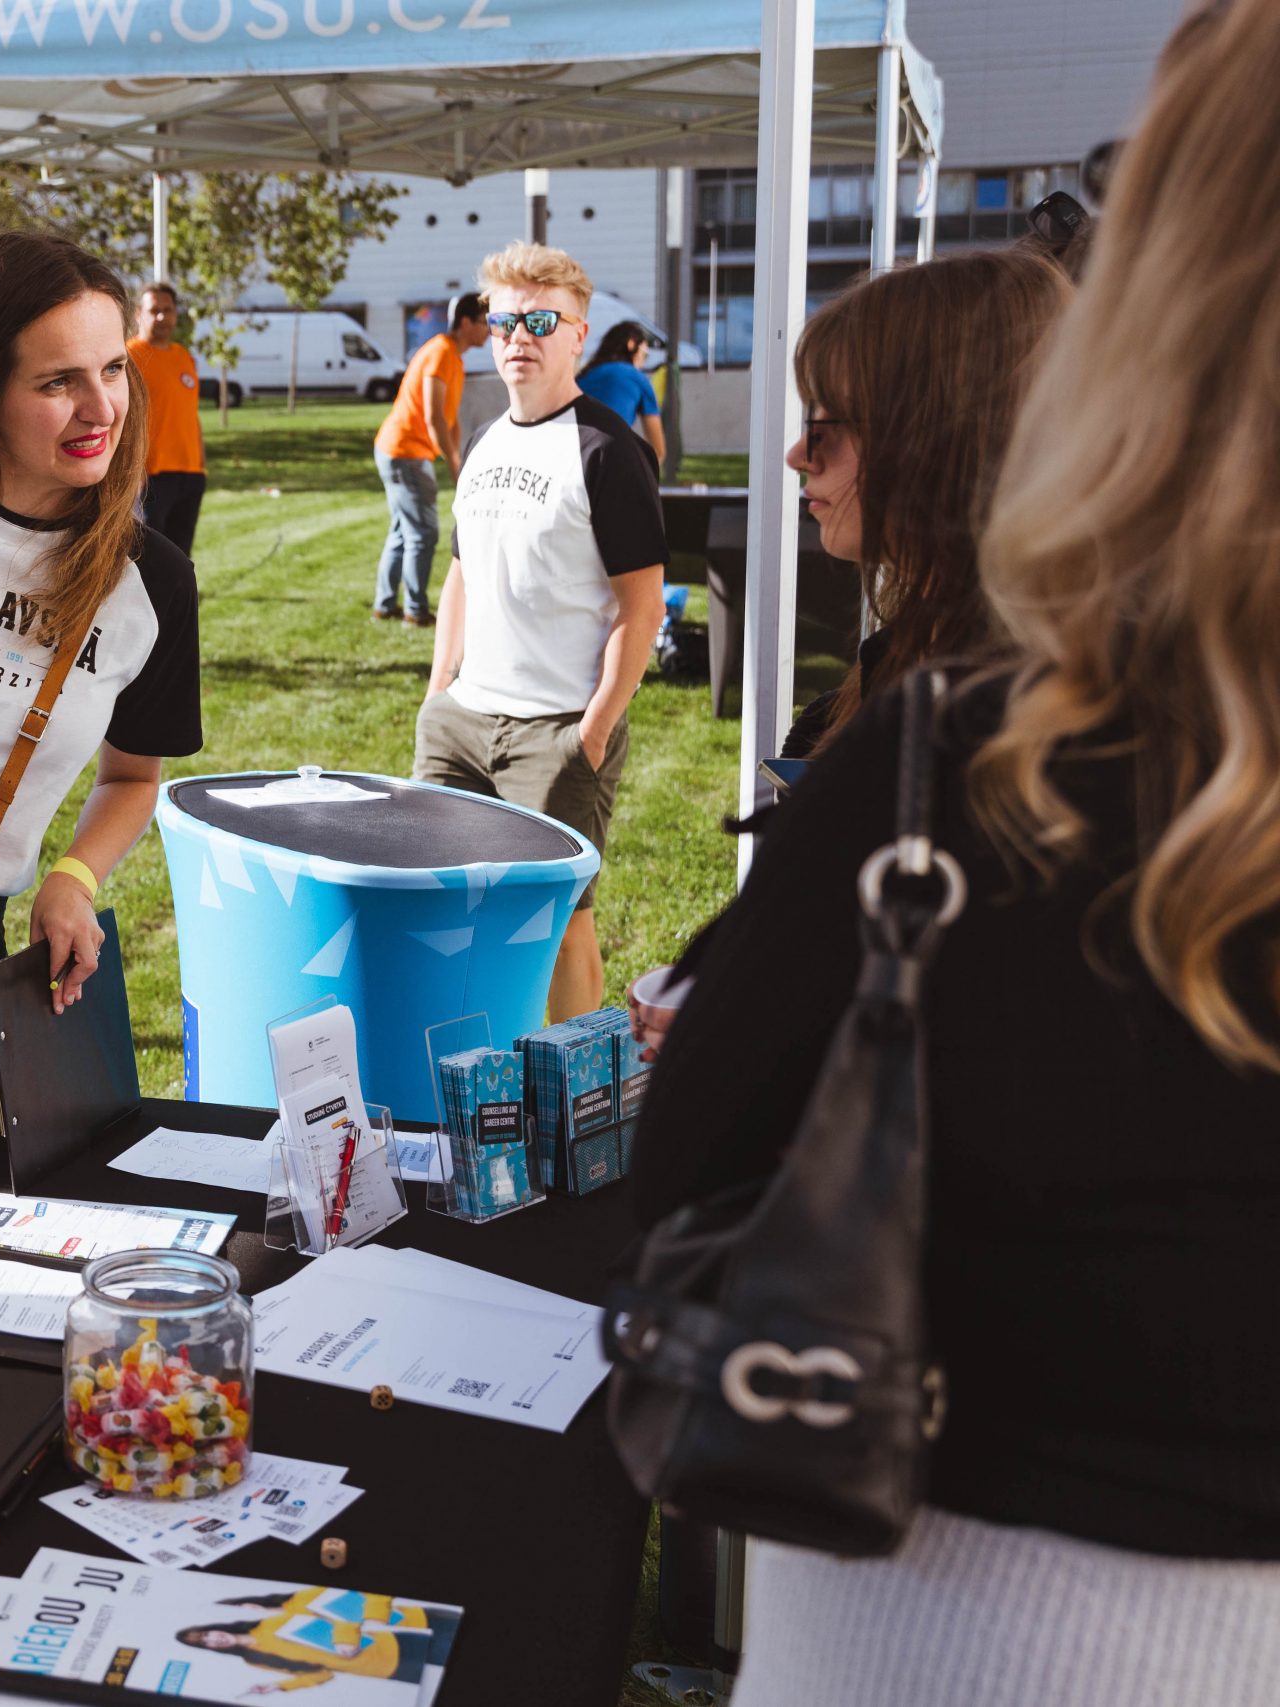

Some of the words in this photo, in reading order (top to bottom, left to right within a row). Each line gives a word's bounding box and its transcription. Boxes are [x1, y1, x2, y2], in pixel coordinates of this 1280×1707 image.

[6, 651, 24, 664] 1991
[481, 1105, 509, 1116] COUNSELLING
[508, 1105, 518, 1114] AND
[484, 1118, 500, 1127] CAREER
[500, 1116, 516, 1126] CENTRE
[344, 1317, 378, 1341] CENTRUM
